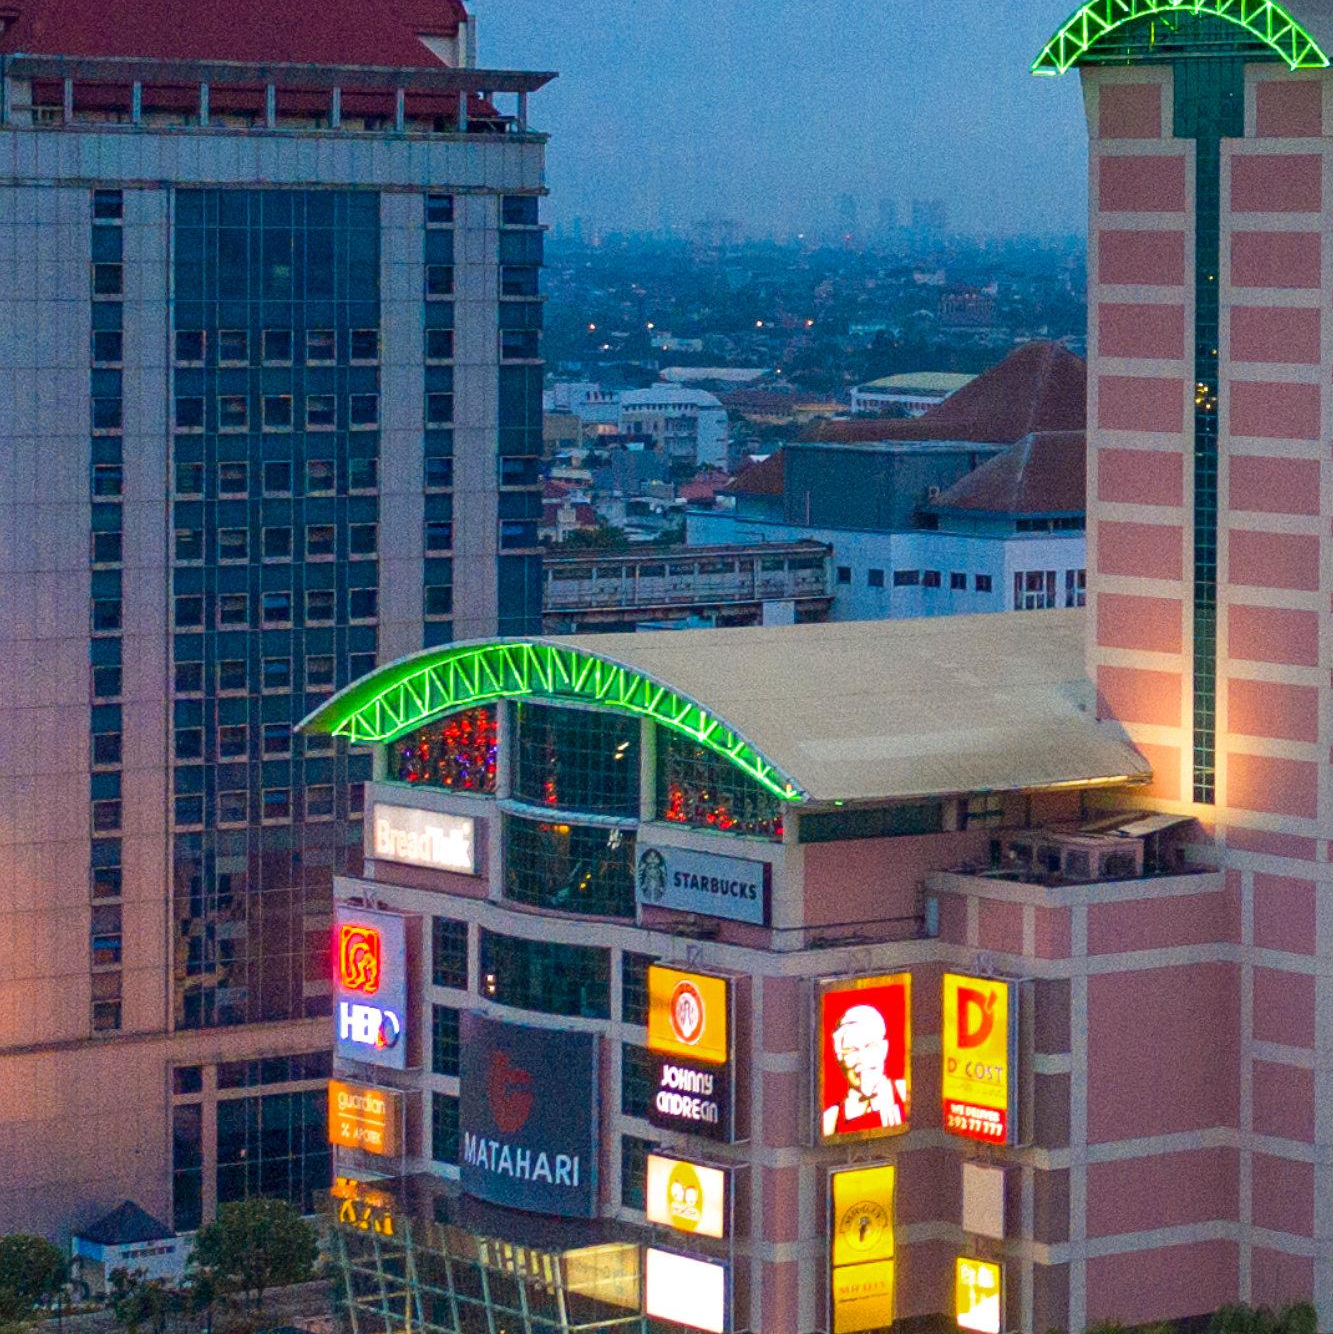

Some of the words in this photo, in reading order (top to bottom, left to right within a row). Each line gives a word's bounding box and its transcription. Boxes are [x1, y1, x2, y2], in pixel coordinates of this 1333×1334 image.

[674, 871, 758, 900] STARBUCKS
[340, 1002, 400, 1048] HERO
[965, 1061, 1003, 1083] COST
[337, 1091, 386, 1116] guardian
[463, 1131, 580, 1187] MATAHARI
